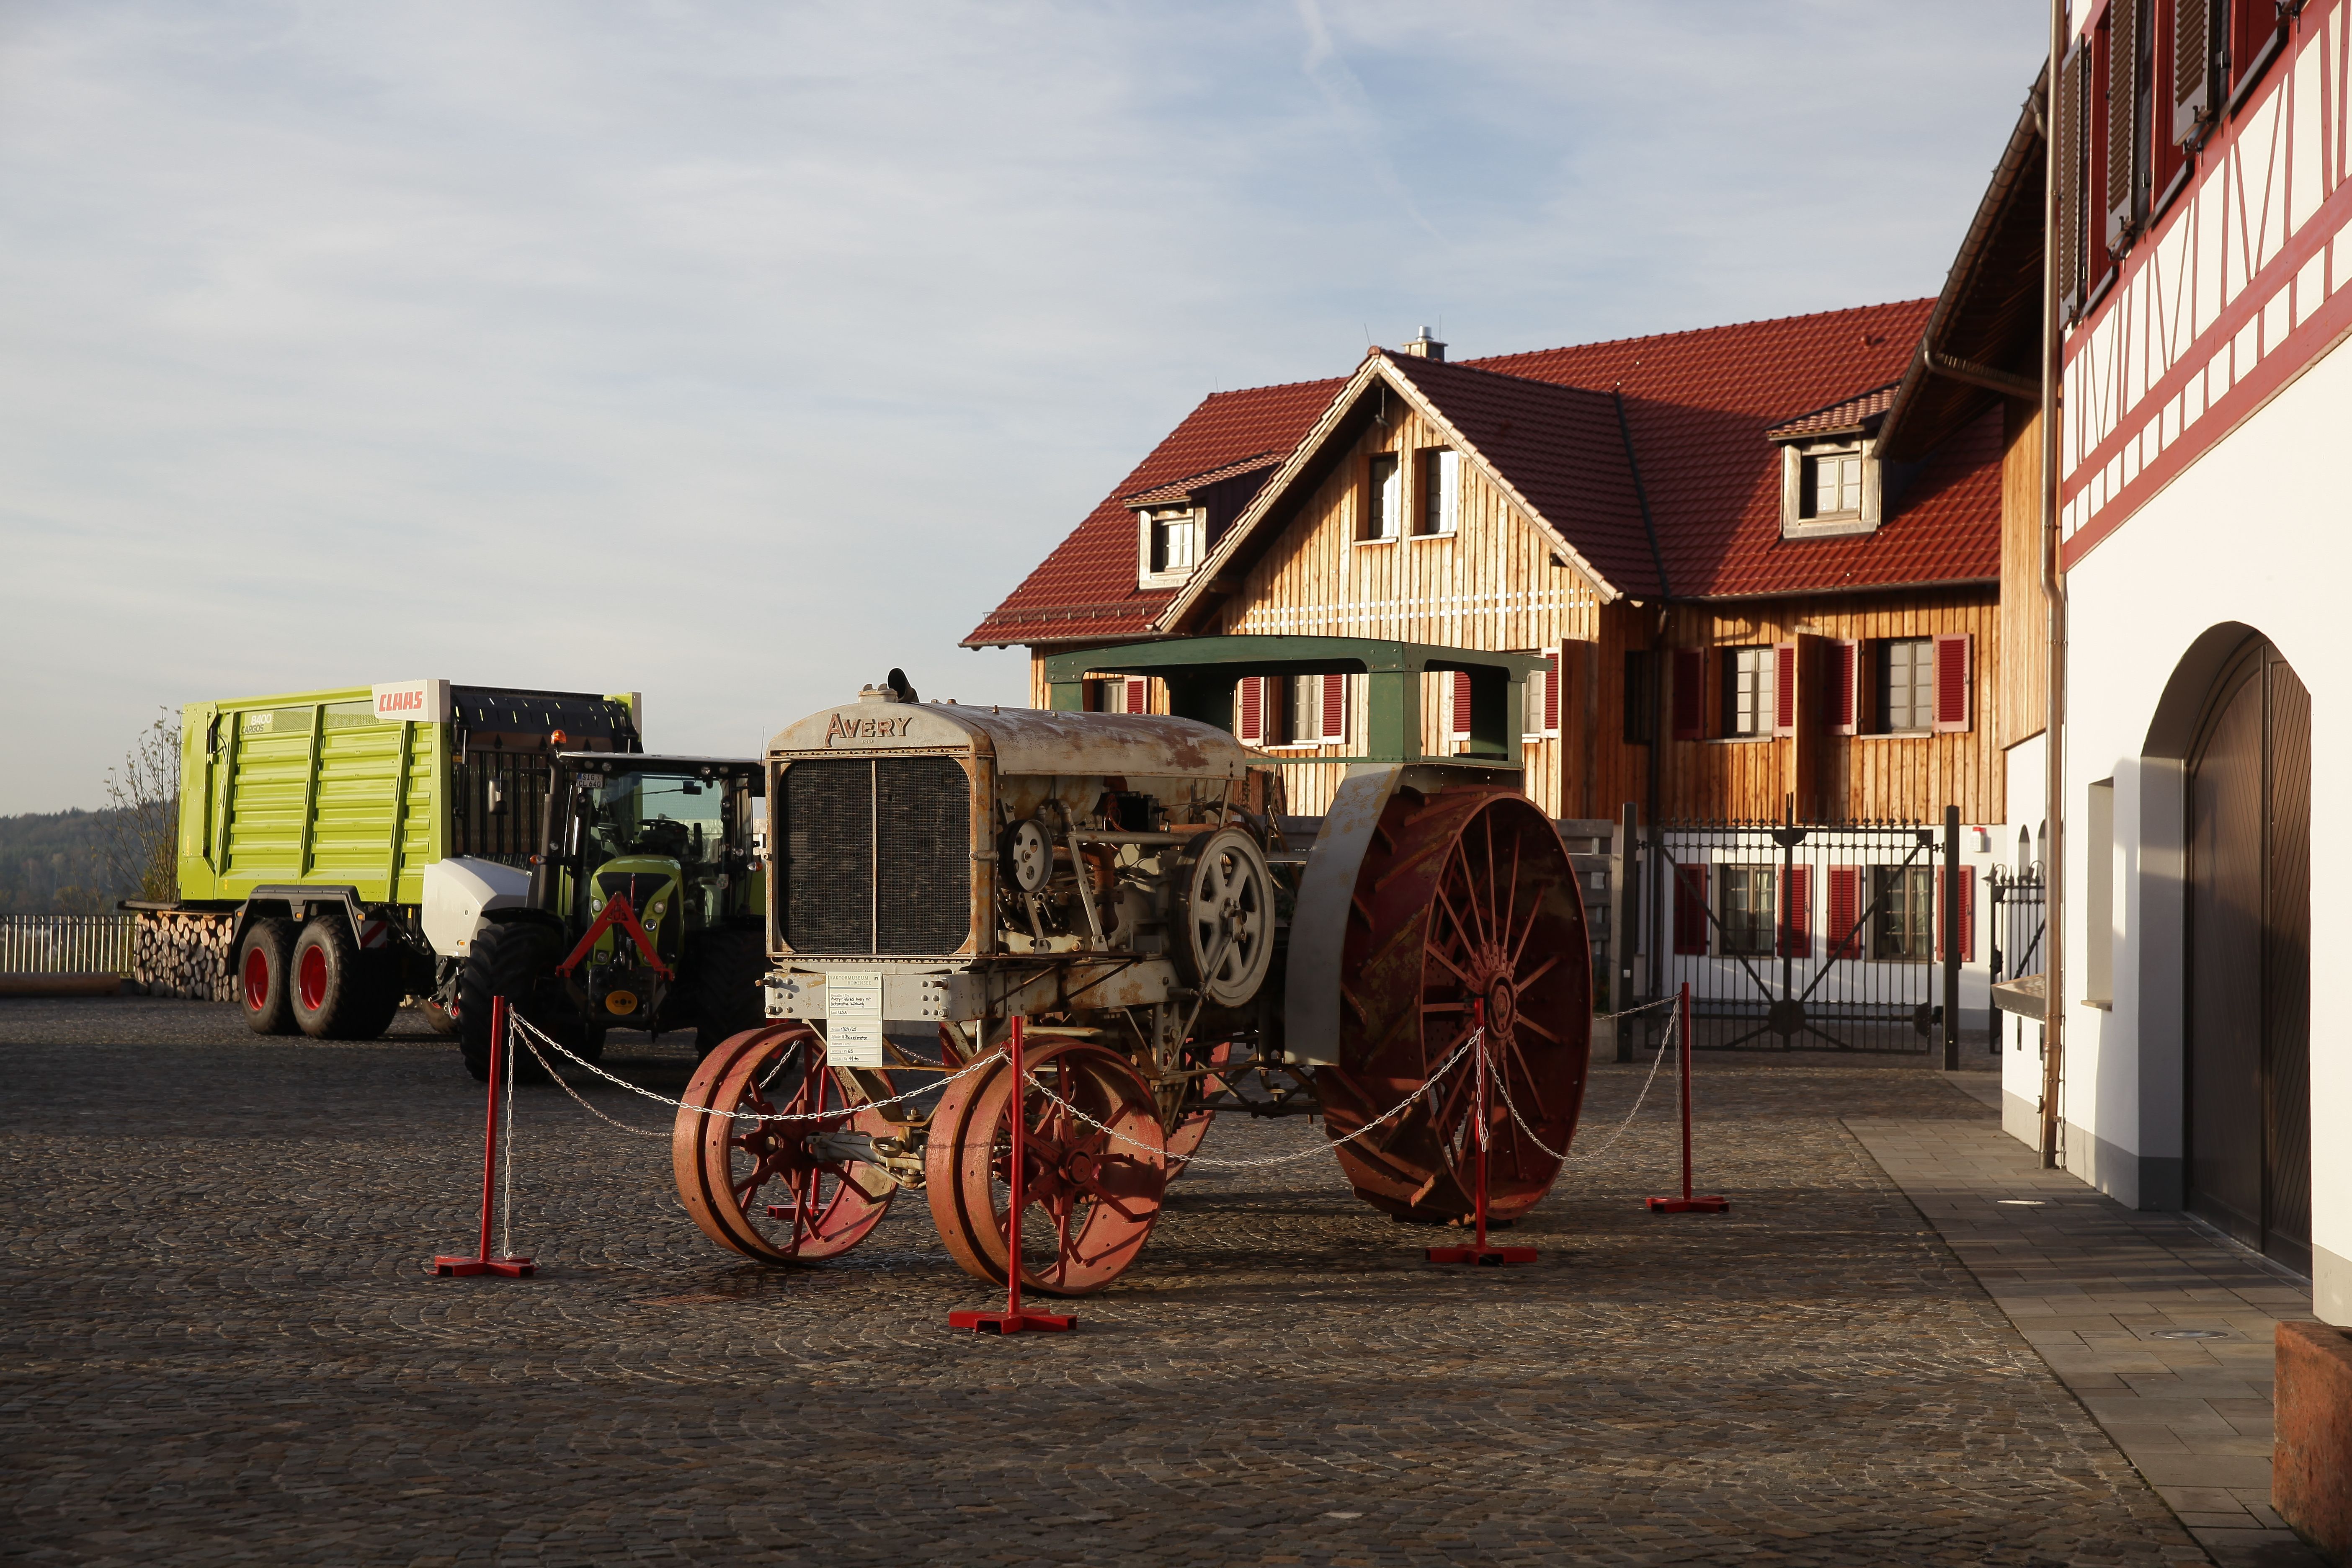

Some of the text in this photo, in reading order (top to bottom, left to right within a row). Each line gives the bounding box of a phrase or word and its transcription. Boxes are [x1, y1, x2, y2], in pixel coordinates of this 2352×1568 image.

[379, 691, 423, 712] CLAAS
[251, 714, 271, 725] 8400
[241, 725, 264, 734] CARGOS
[825, 713, 913, 747] AVERY
